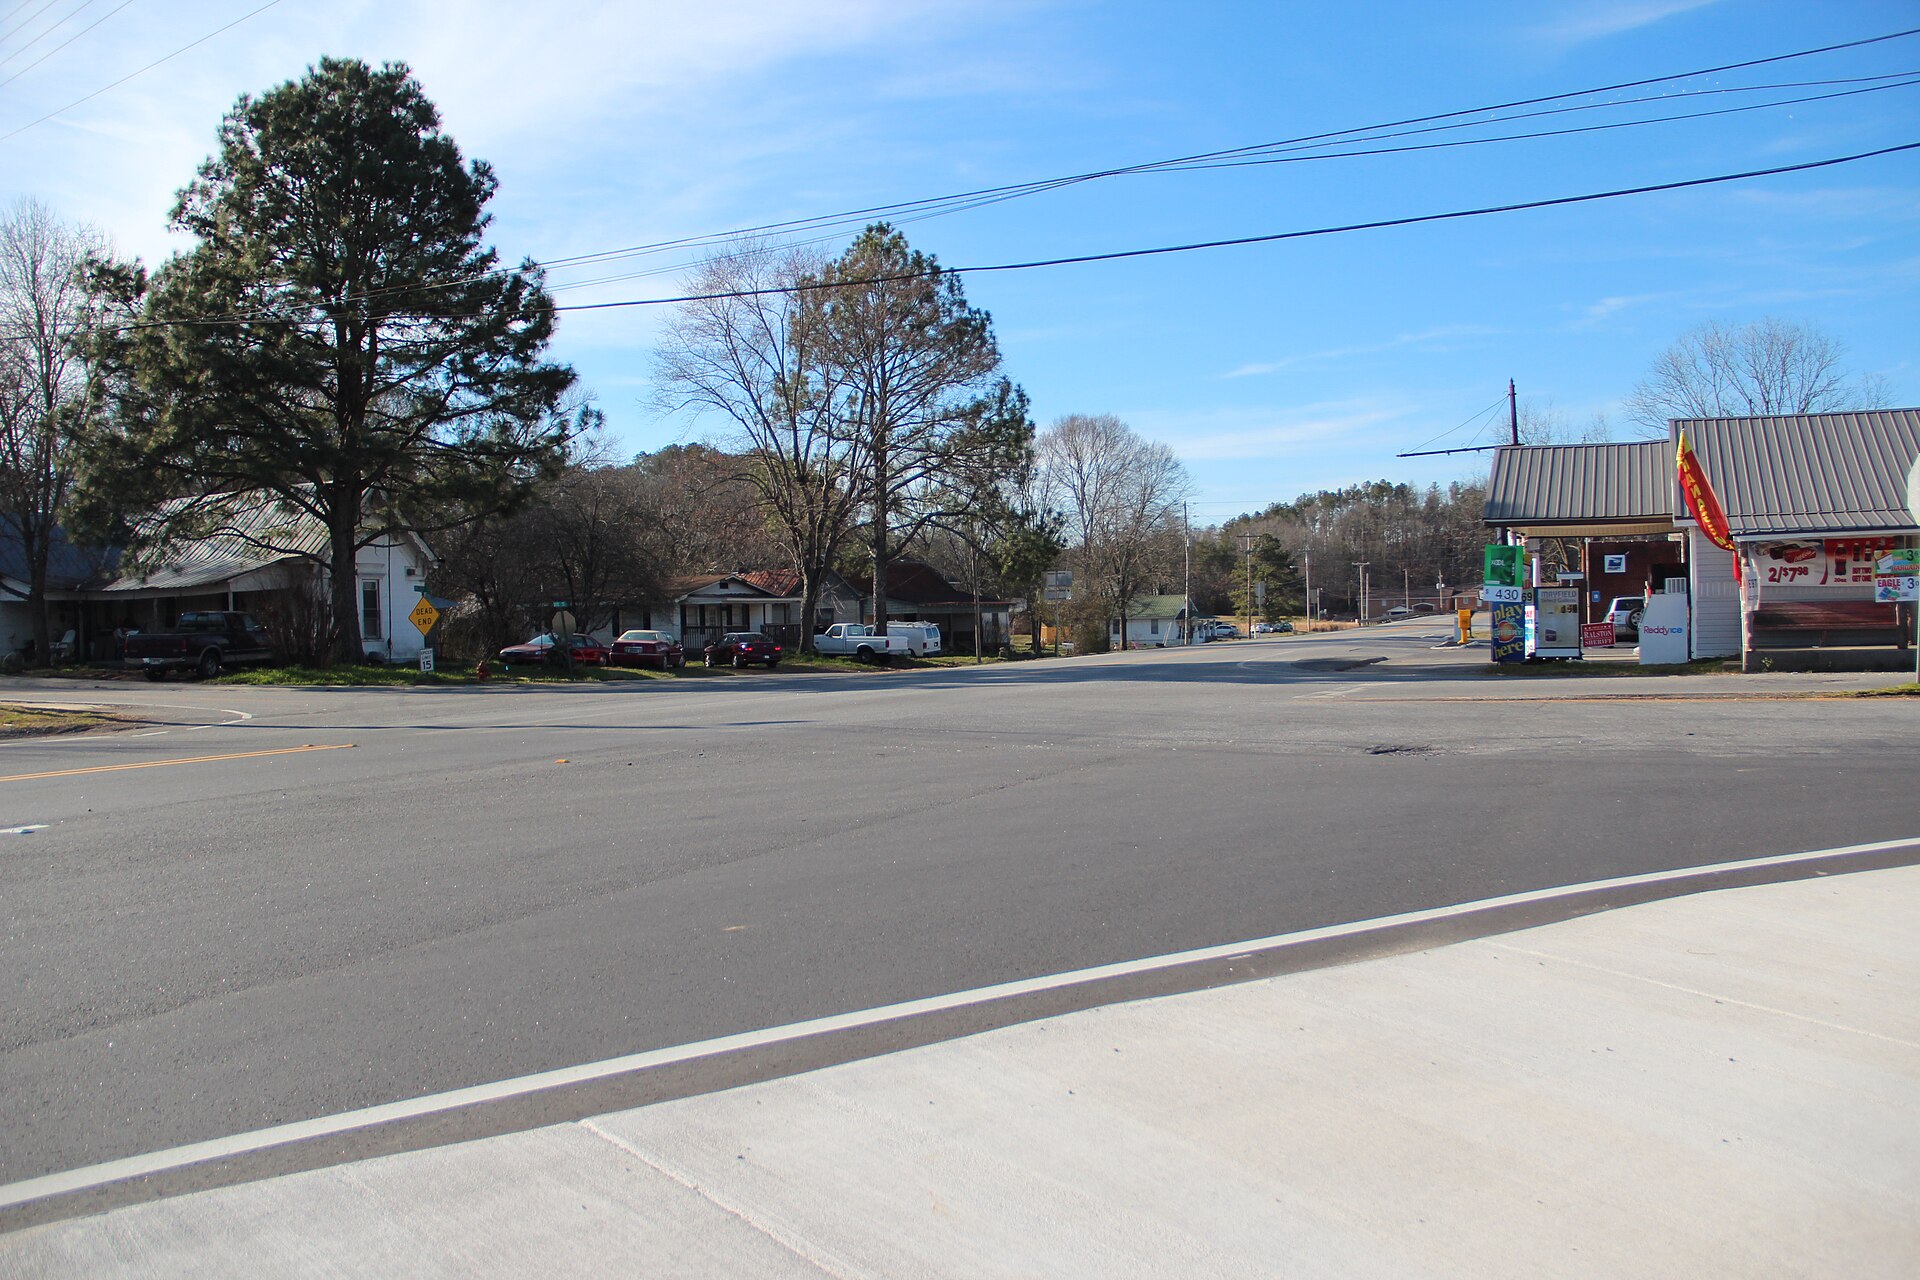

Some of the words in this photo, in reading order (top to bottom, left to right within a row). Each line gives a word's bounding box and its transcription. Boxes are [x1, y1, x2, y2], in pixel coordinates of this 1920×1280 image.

[1851, 575, 1861, 583] GET
[1862, 575, 1872, 583] ONE
[1877, 578, 1901, 588] EAGLE
[416, 607, 433, 616] DEAD
[1494, 603, 1525, 625] play
[417, 618, 432, 626] END
[1583, 629, 1613, 639] RALSTON
[1584, 638, 1613, 646] SHERIFF
[1494, 641, 1524, 659] here
[422, 660, 432, 670] 15
